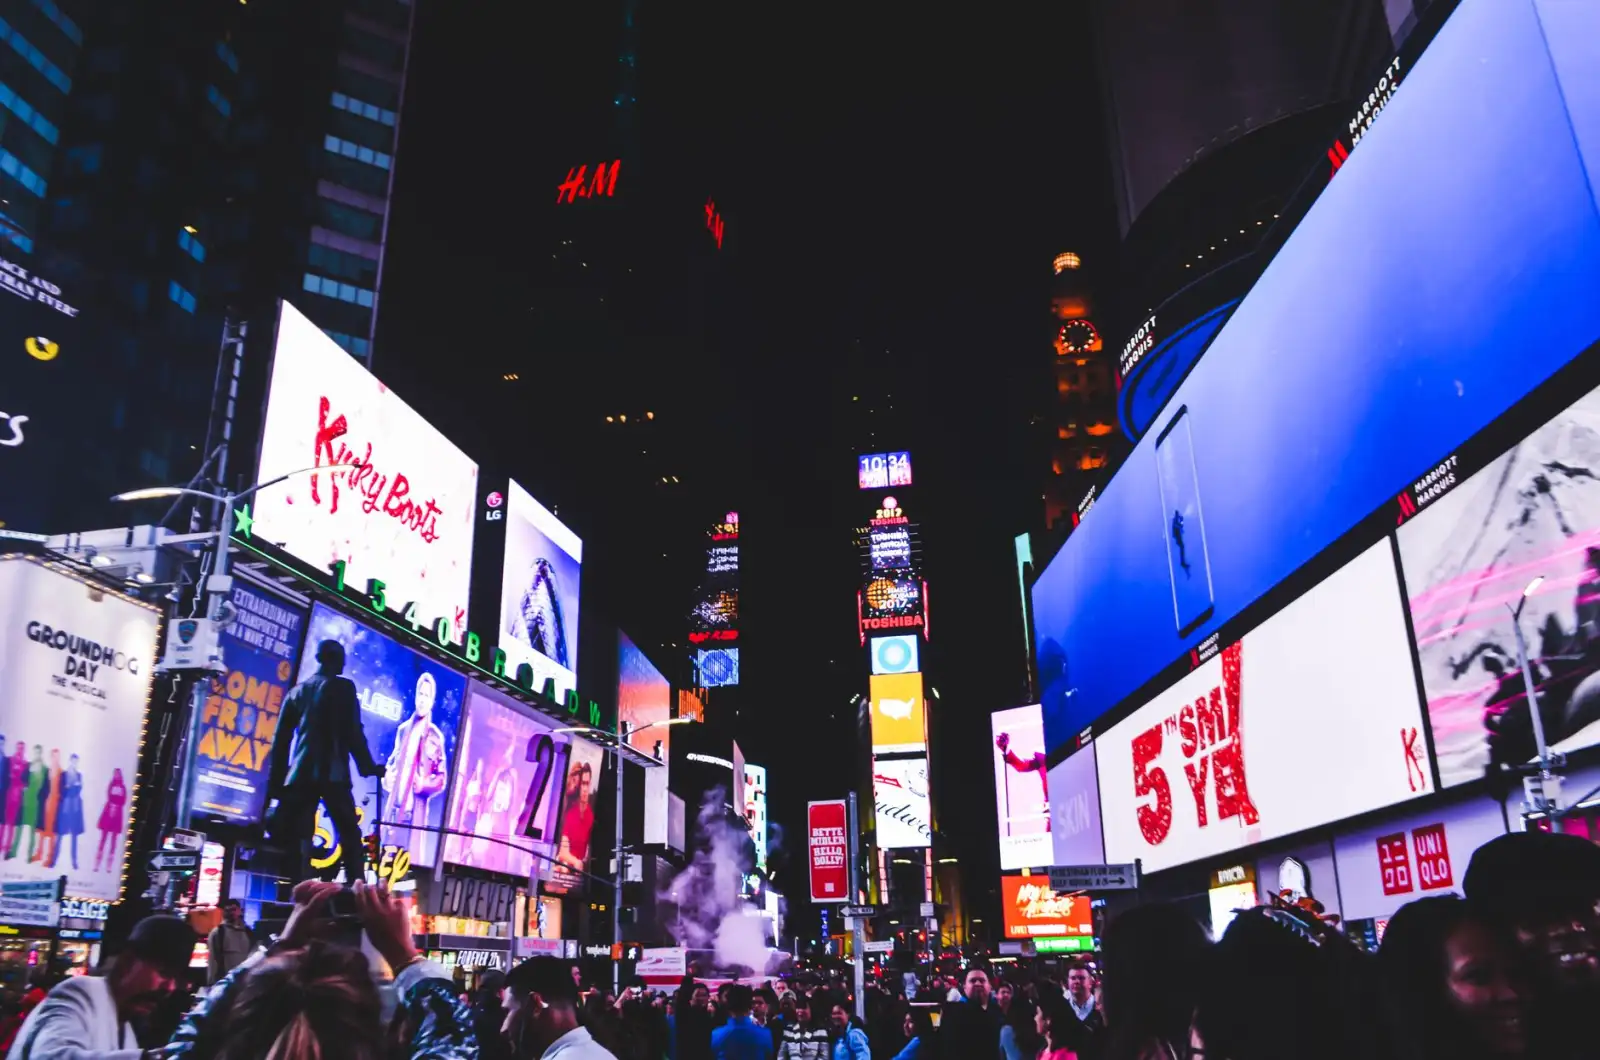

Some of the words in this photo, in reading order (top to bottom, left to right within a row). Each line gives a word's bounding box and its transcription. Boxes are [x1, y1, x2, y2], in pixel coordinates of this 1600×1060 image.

[1349, 56, 1400, 134] MARRIOTT
[557, 159, 621, 204] H&M
[309, 396, 386, 514] Kinky
[1414, 454, 1458, 493] MARRIOTT
[1416, 473, 1456, 506] MARQUIS
[382, 472, 443, 544] Boots
[486, 511, 501, 521] LG
[870, 516, 908, 526] TOSHIBA
[329, 560, 450, 646] 1540
[862, 615, 923, 629] TOSHIBA
[26, 620, 139, 676] GROUNDHOG
[64, 655, 99, 682] DAY
[52, 674, 67, 687] THE
[71, 681, 107, 700] MUSICAL
[197, 727, 272, 772] AWAY
[515, 733, 573, 845] 21
[812, 827, 844, 837] BETTE
[1416, 832, 1441, 857] UNI
[163, 857, 176, 865] ONE
[179, 857, 195, 865] WAY
[1421, 857, 1448, 886] QLO
[440, 876, 516, 922] FOREVER
[457, 949, 489, 967] FOREVER
